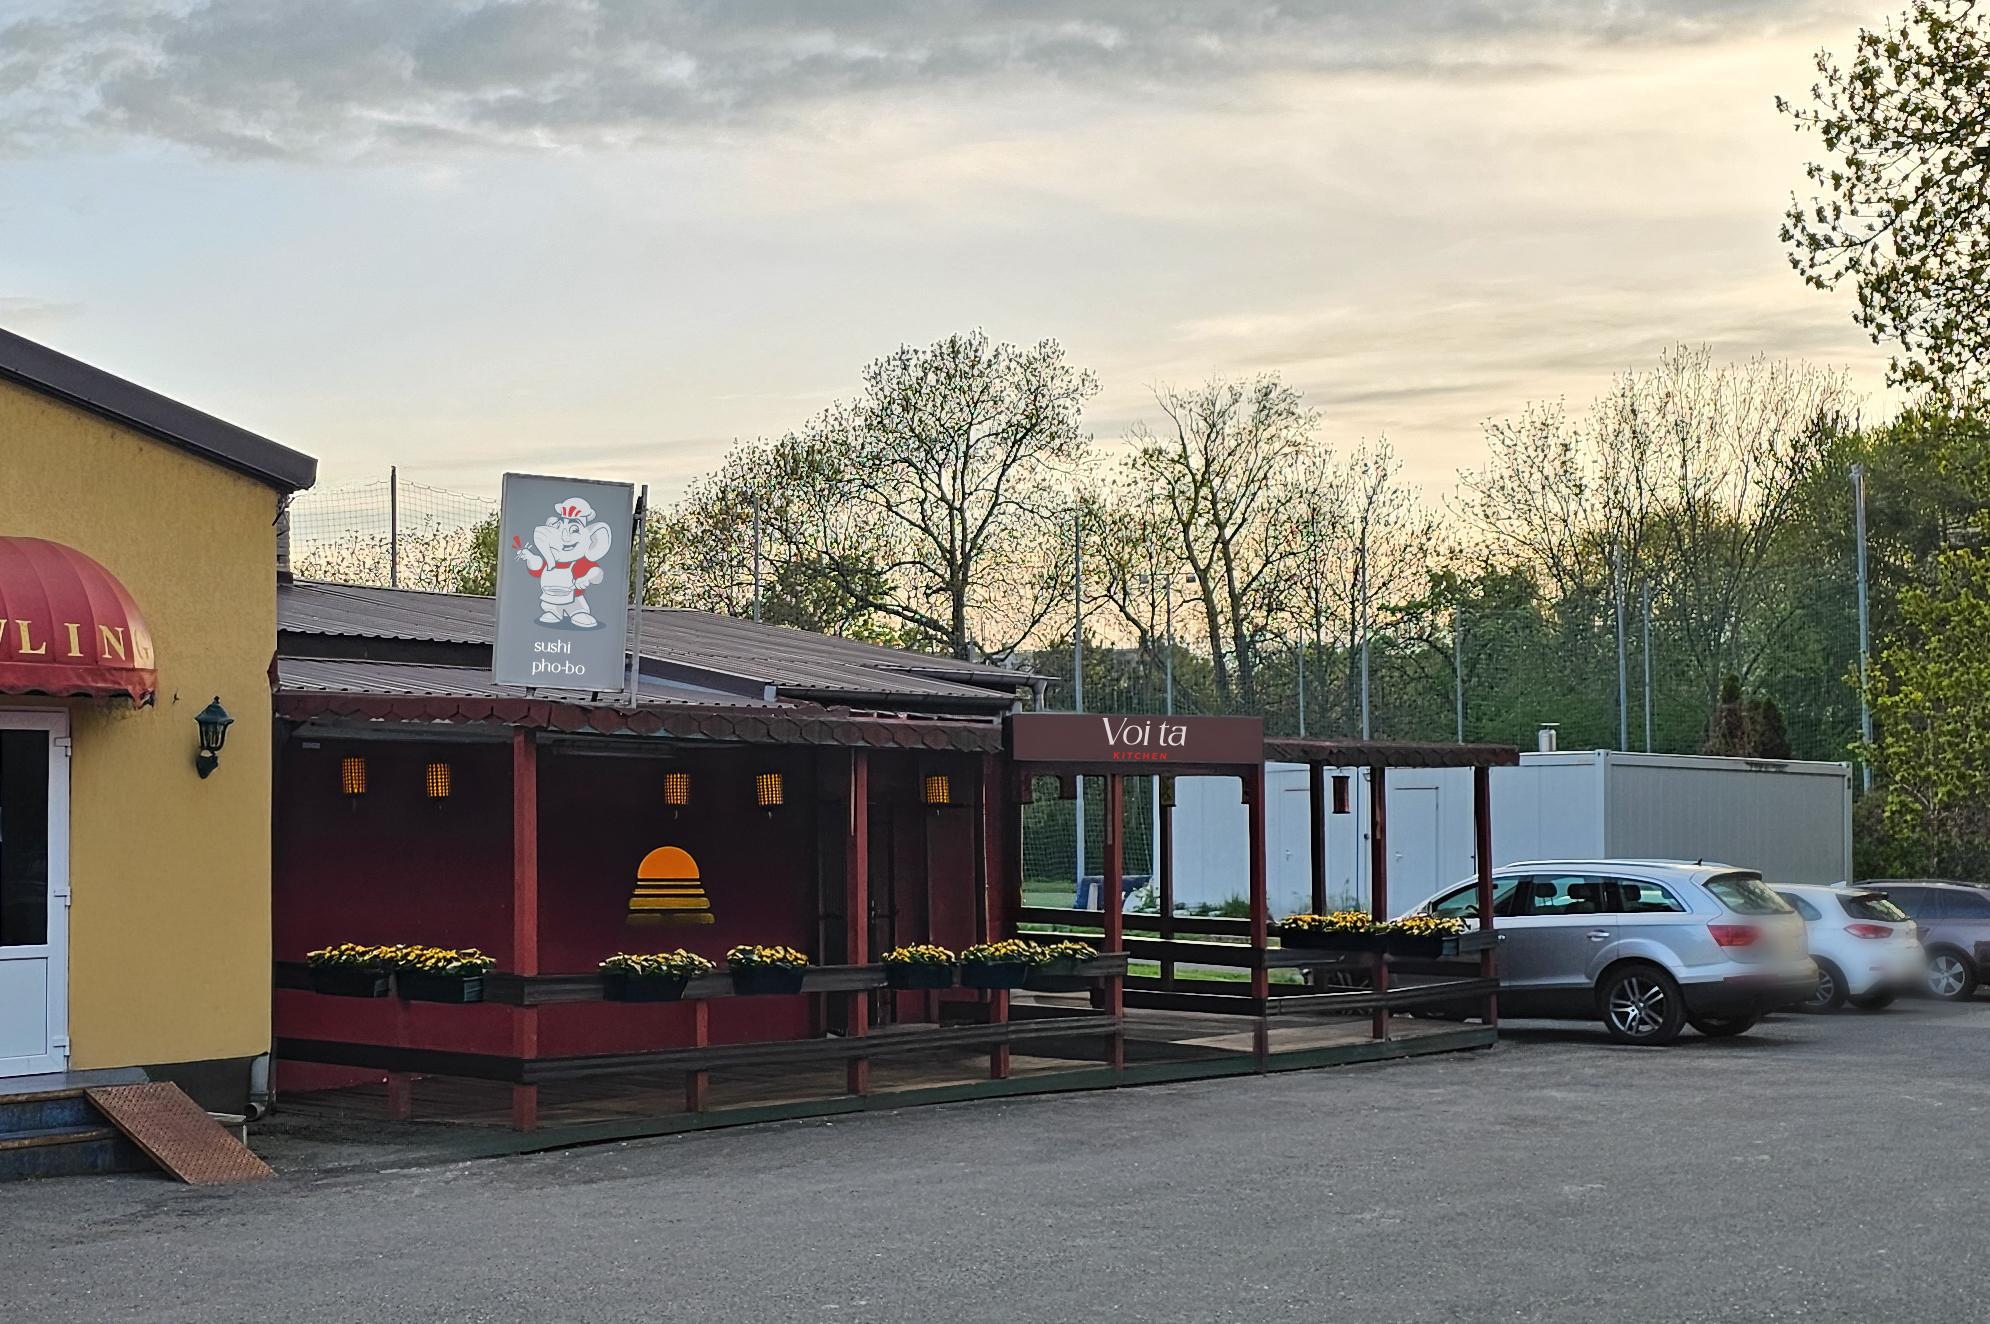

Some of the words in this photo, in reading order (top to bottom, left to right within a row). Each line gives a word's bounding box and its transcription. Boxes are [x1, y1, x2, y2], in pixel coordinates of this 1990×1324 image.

[0, 619, 152, 662] LING
[534, 639, 571, 654] sushi
[532, 658, 585, 675] pho-bo
[1102, 717, 1151, 746] Voi
[1159, 720, 1188, 746] ta
[1113, 751, 1168, 760] KITCHEN
